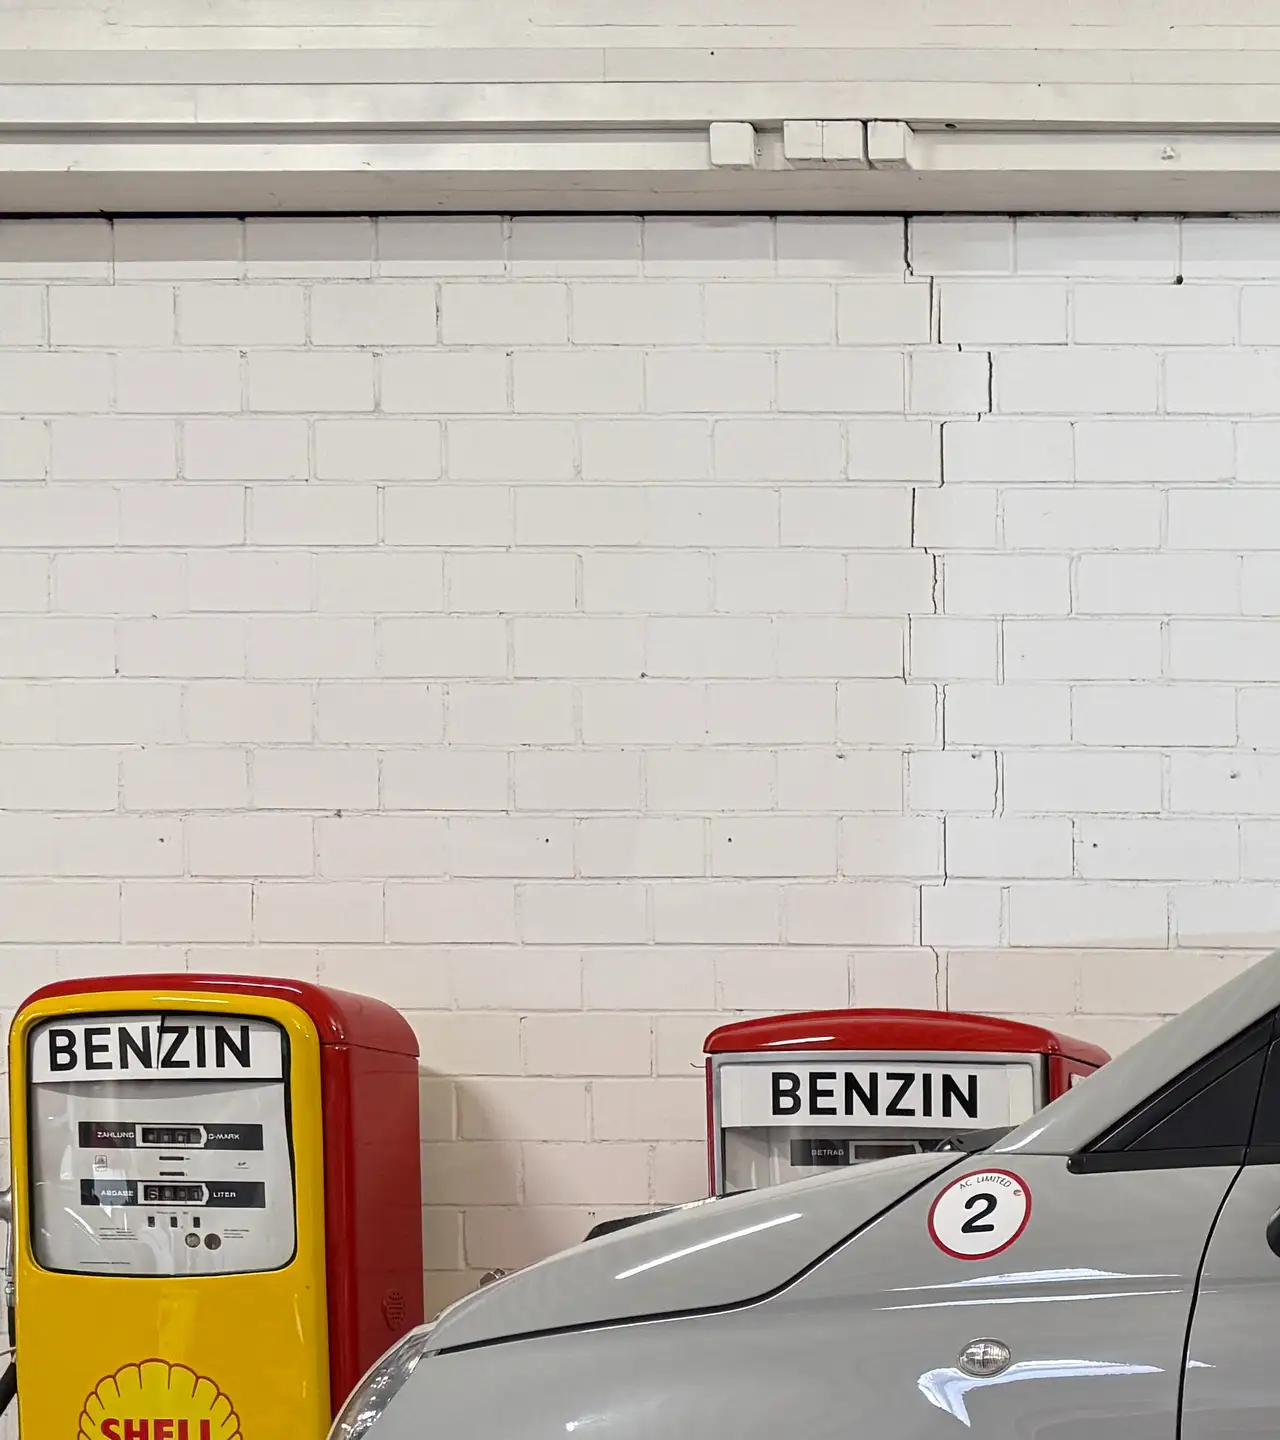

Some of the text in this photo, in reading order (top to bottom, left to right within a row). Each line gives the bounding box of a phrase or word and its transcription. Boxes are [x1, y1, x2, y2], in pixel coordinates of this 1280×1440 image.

[49, 1025, 251, 1072] BENZIN
[771, 1071, 979, 1119] BENZIN
[97, 1131, 135, 1139] ZAHLUNG
[976, 1175, 1012, 1188] LIMITED
[961, 1193, 997, 1234] 2
